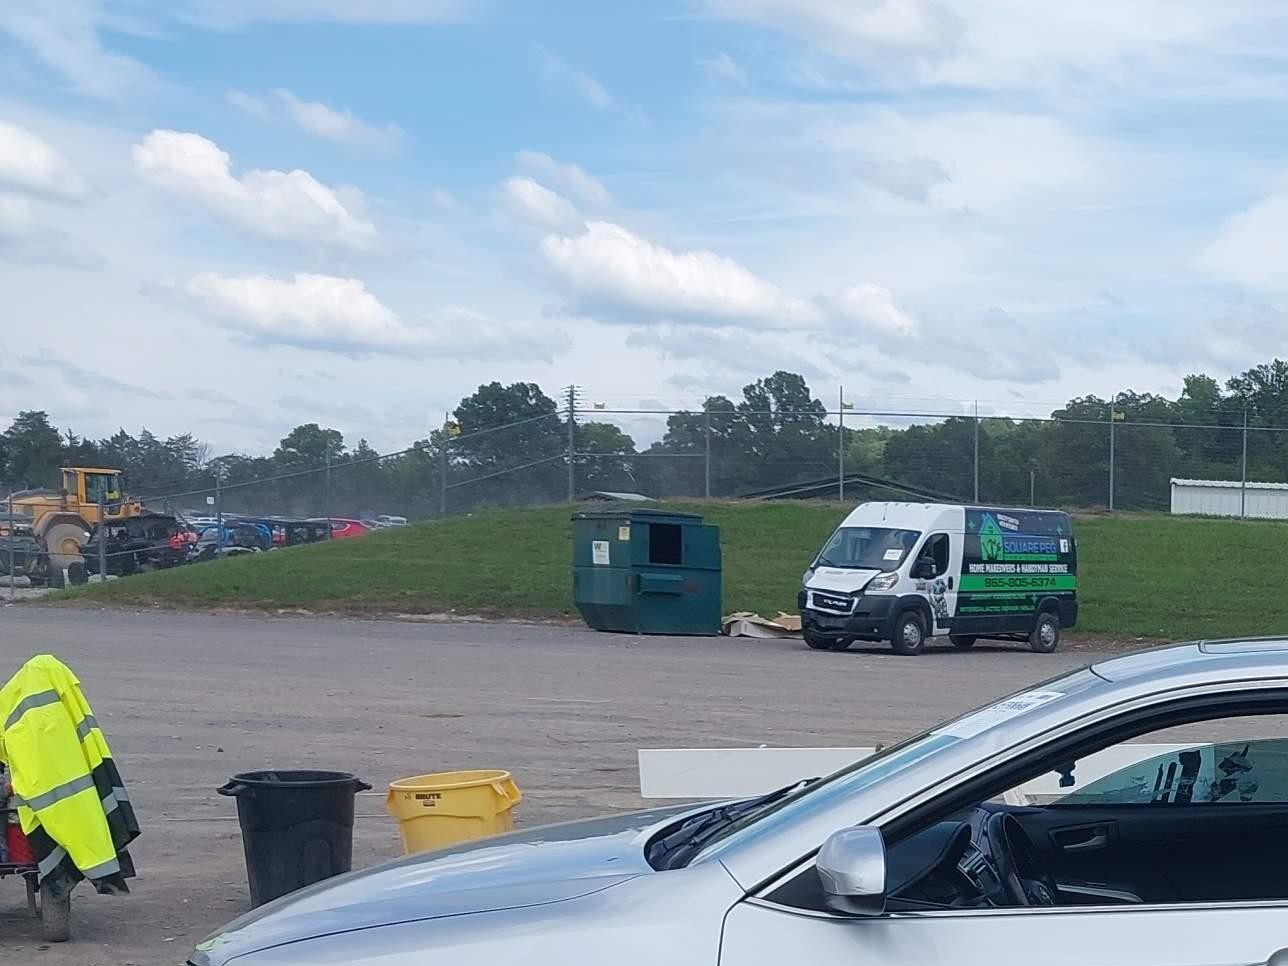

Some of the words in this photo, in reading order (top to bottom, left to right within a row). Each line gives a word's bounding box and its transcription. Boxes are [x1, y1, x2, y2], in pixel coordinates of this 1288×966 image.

[969, 564, 985, 573] HOME
[986, 564, 1015, 573] MAKEOVERS
[1021, 564, 1048, 573] HANDYMAN
[1049, 564, 1068, 573] SERVICE
[985, 578, 1056, 588] 865-805-6374
